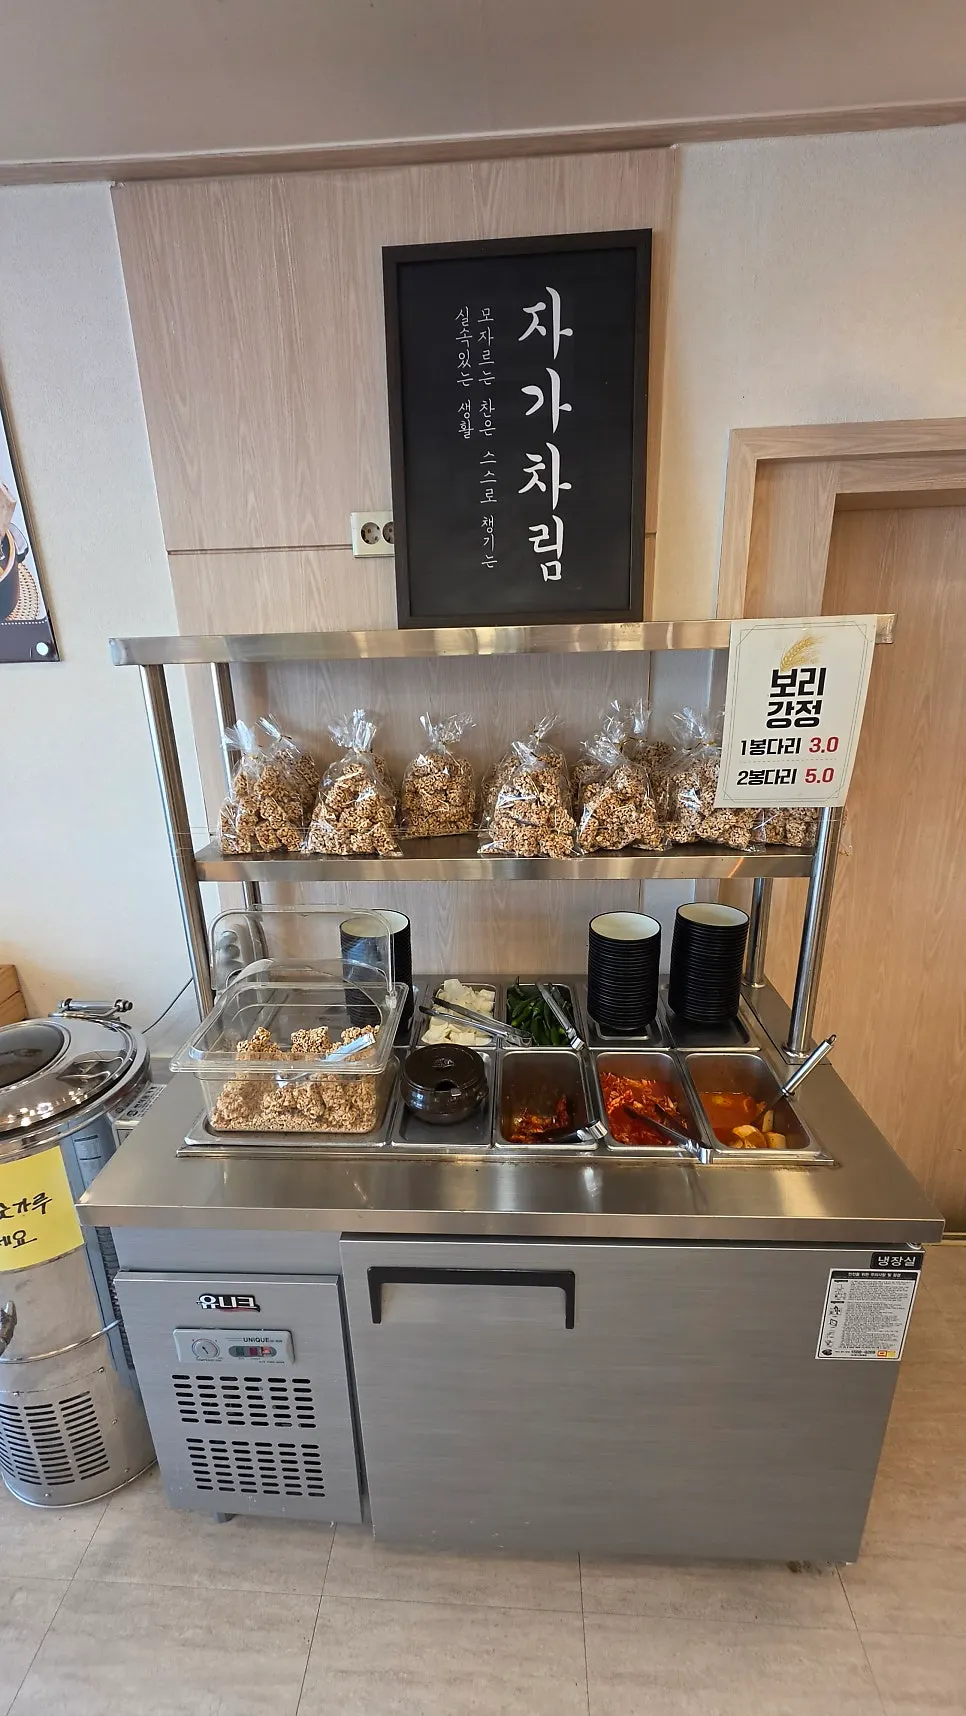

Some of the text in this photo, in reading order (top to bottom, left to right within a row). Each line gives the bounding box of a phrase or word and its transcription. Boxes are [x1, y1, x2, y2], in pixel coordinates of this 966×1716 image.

[455, 306, 474, 439] 실속있는 생활
[477, 307, 498, 569] 모자르는 찬은 스스로 챙기는
[518, 286, 573, 582] 자가차림
[769, 667, 827, 698] 보리
[766, 699, 823, 729] 강정
[741, 736, 840, 756] 1봉다리 3.0
[736, 767, 835, 786] 2봉다리 5.0
[877, 1255, 916, 1267] 냉장실
[197, 1294, 259, 1310] 유니크
